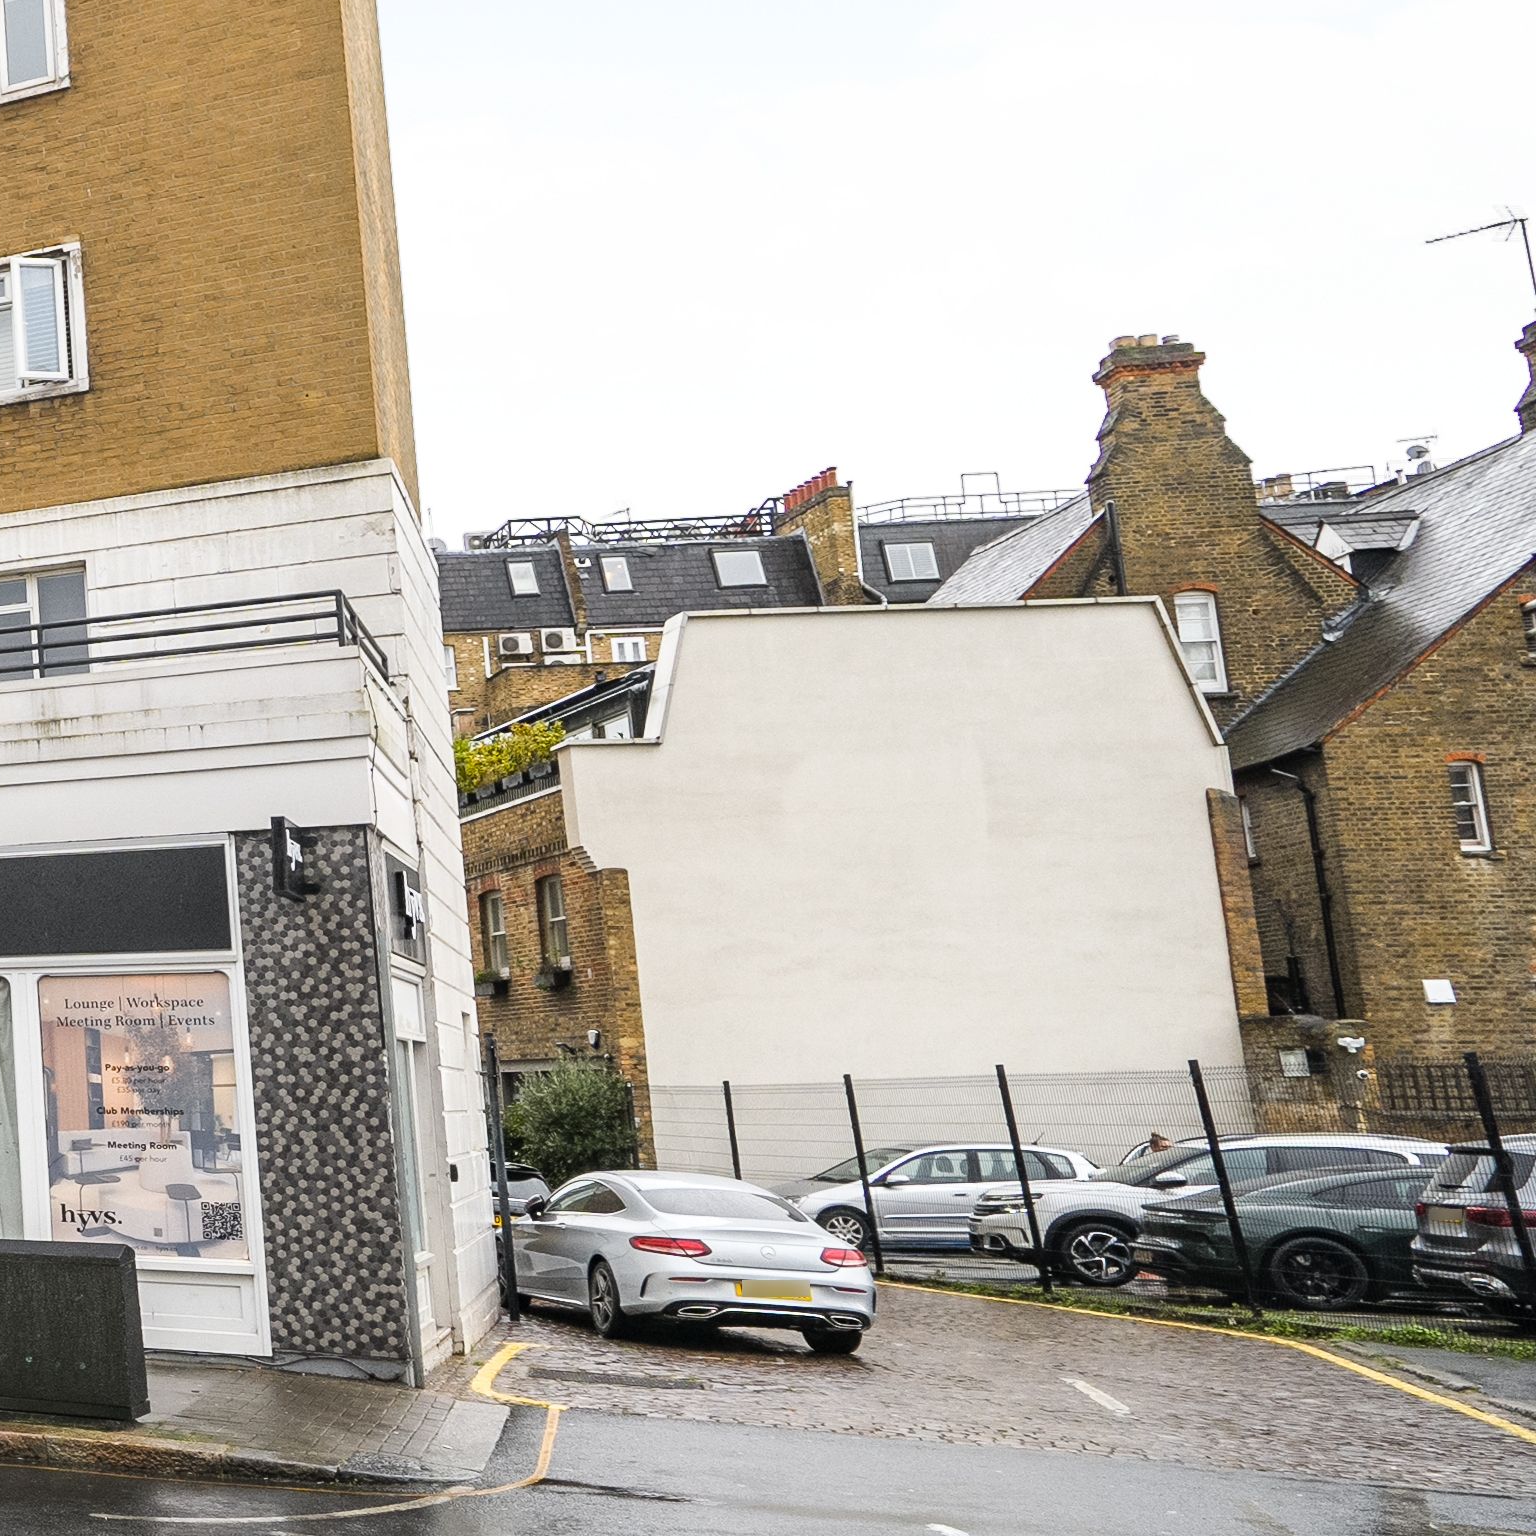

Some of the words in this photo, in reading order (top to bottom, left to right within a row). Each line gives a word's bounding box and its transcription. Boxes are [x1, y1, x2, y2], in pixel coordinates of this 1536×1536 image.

[64, 998, 114, 1011] Lounge
[127, 995, 204, 1011] Workspace
[56, 1016, 111, 1029] Meeting
[115, 1015, 155, 1026] Room
[168, 1015, 215, 1026] Events
[105, 1064, 170, 1073] Pay-as-you-go
[96, 1107, 118, 1115] Club
[120, 1107, 185, 1117] Memberships
[107, 1141, 147, 1151] Meeting
[149, 1141, 177, 1150] Room
[149, 1155, 167, 1163] hour
[60, 1204, 123, 1232] hyvs.
